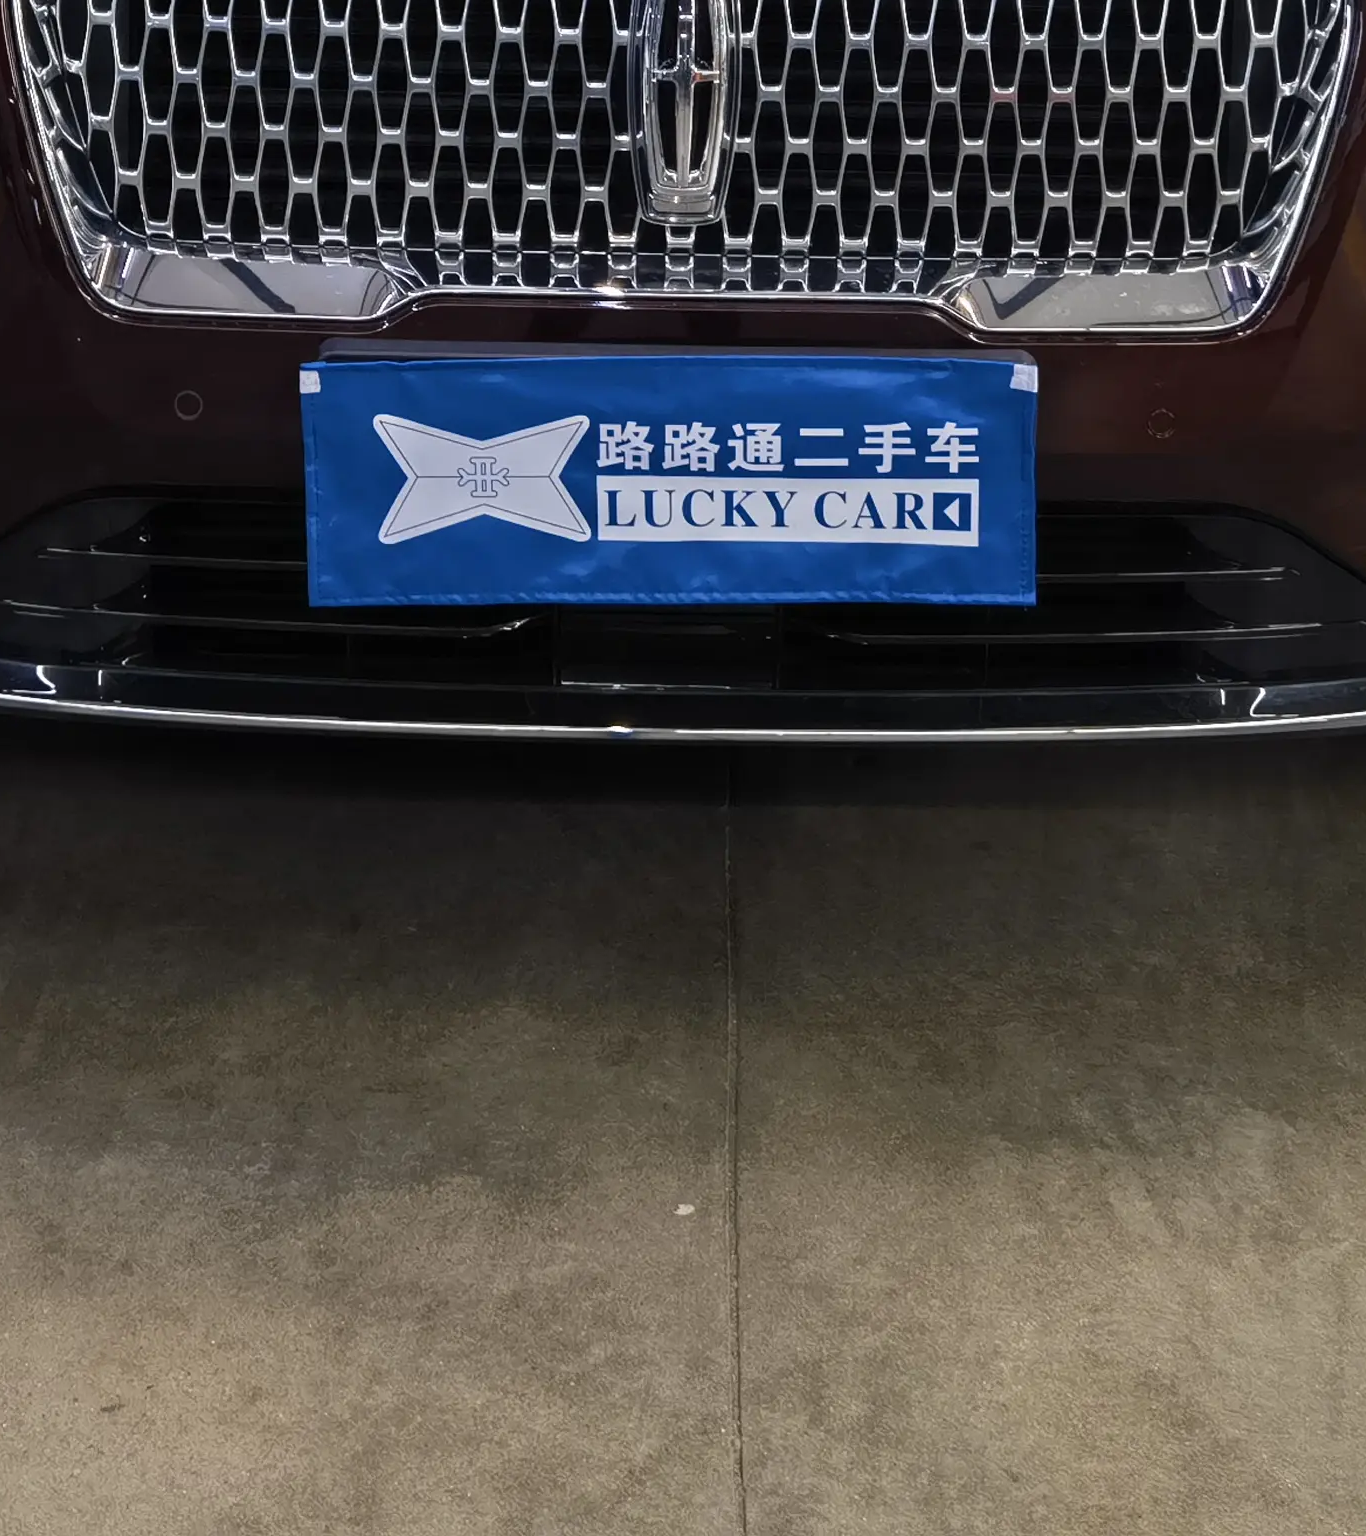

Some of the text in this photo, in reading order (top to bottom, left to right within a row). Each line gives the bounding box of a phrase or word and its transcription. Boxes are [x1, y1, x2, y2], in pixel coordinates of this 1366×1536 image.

[596, 420, 980, 473] 路路通二手车
[603, 488, 928, 530] LUCKY CAR
